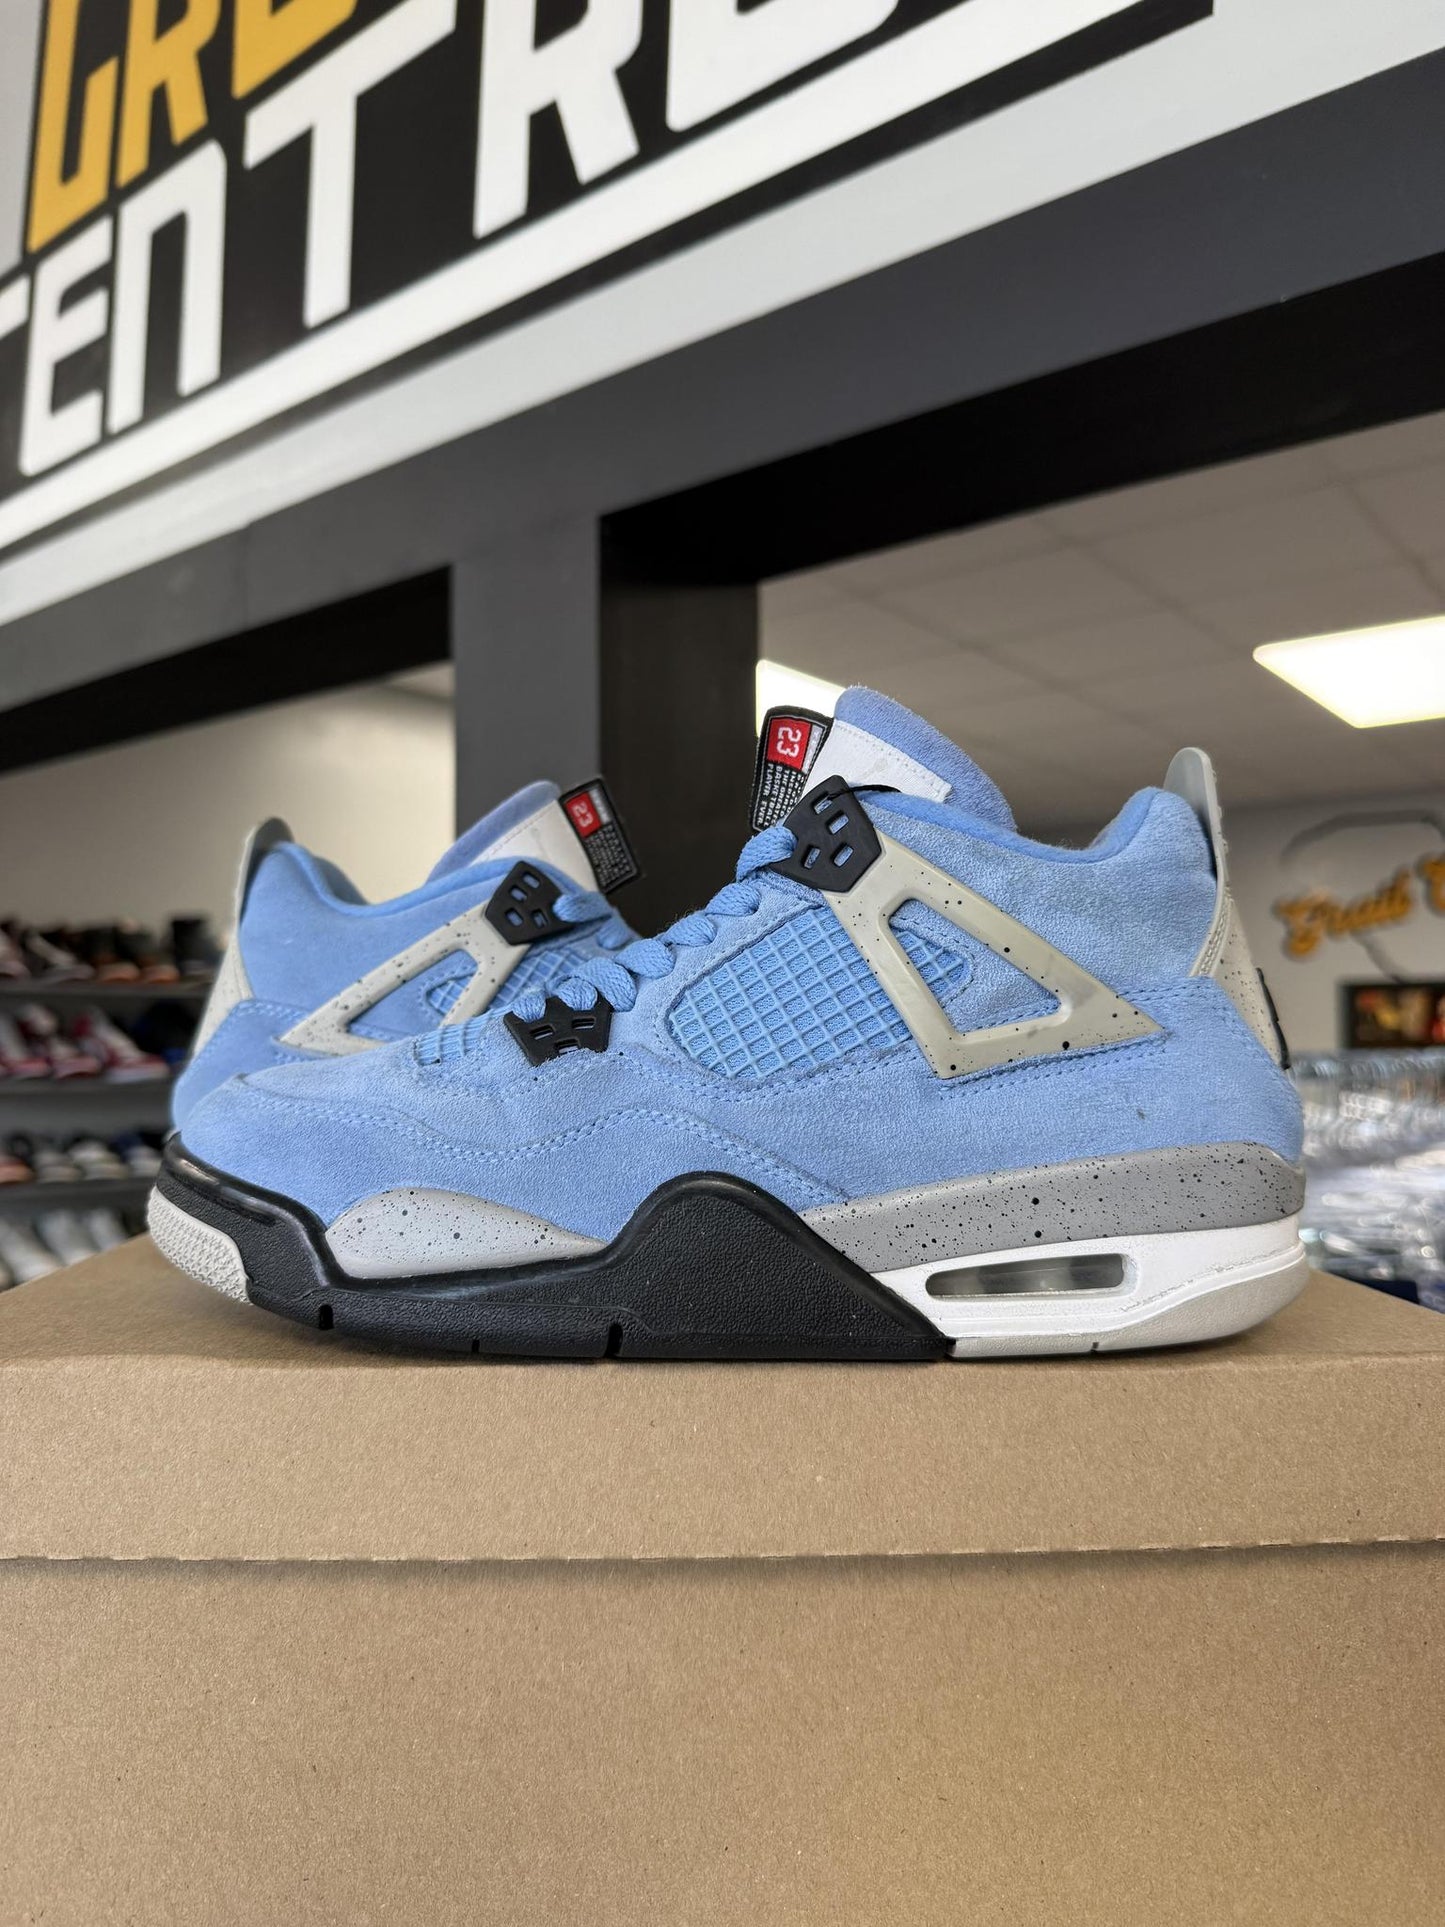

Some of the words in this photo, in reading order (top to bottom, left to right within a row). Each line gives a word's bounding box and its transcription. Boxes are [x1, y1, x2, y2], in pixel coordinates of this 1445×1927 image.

[776, 726, 802, 758] 23
[762, 763, 774, 796] PLAYER
[782, 770, 790, 786] THE
[764, 765, 783, 827] BASKETBALL
[771, 786, 786, 825] GREATES
[572, 801, 594, 828] 23
